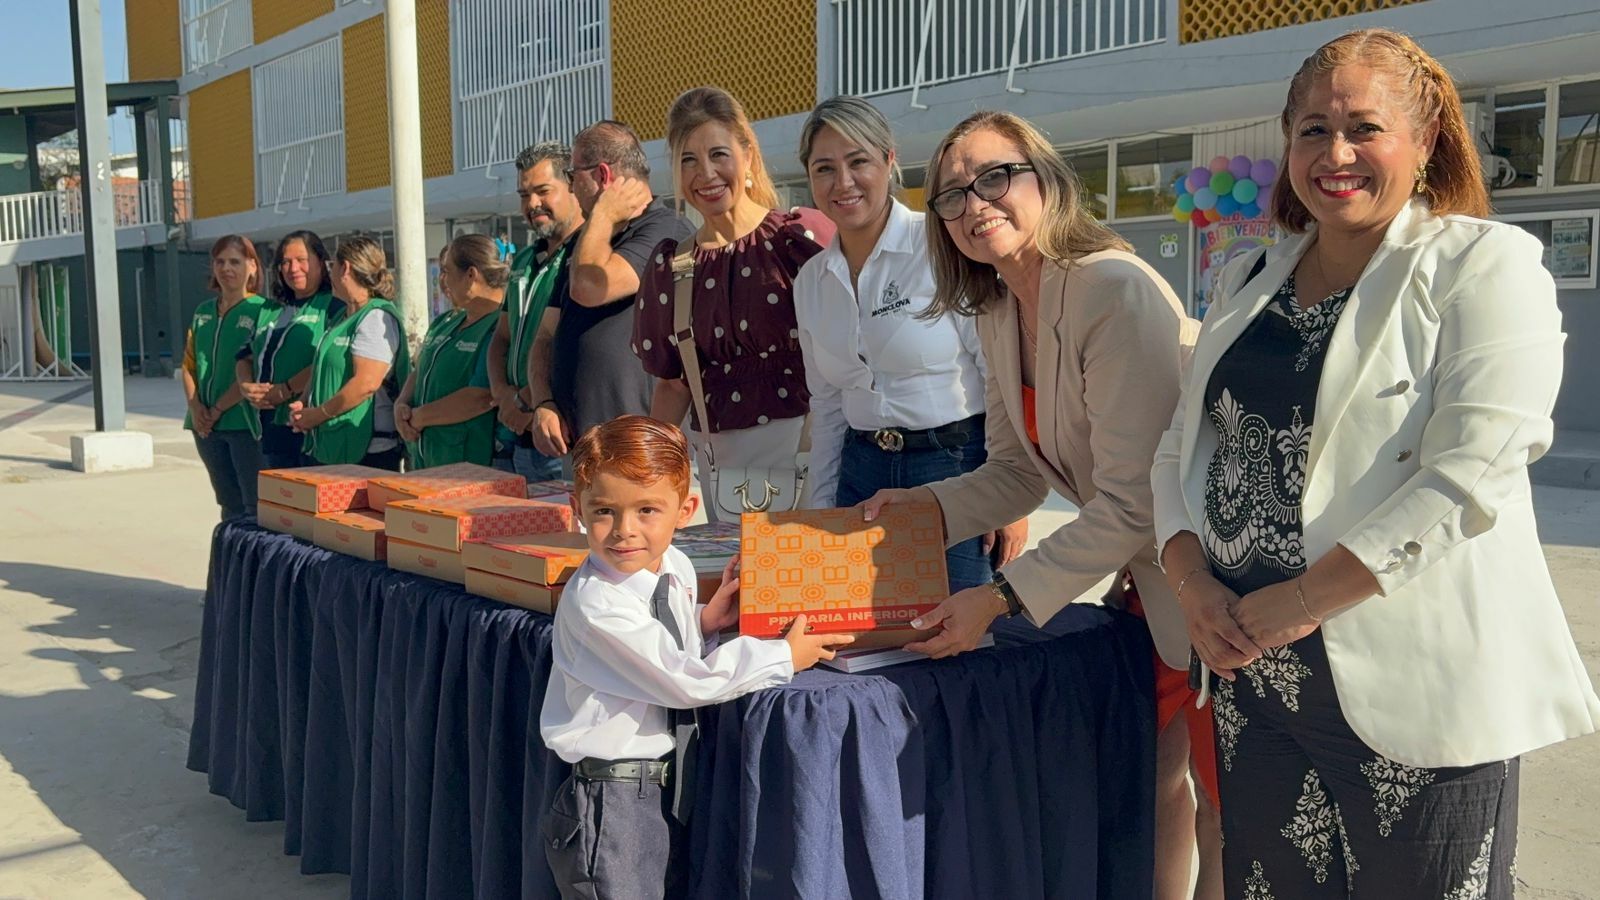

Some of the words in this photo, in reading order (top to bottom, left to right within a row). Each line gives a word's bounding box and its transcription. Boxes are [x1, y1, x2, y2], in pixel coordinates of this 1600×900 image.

[871, 298, 911, 317] MONCLOVA
[768, 613, 844, 626] PRIARIA
[847, 609, 919, 621] INFERIOR
